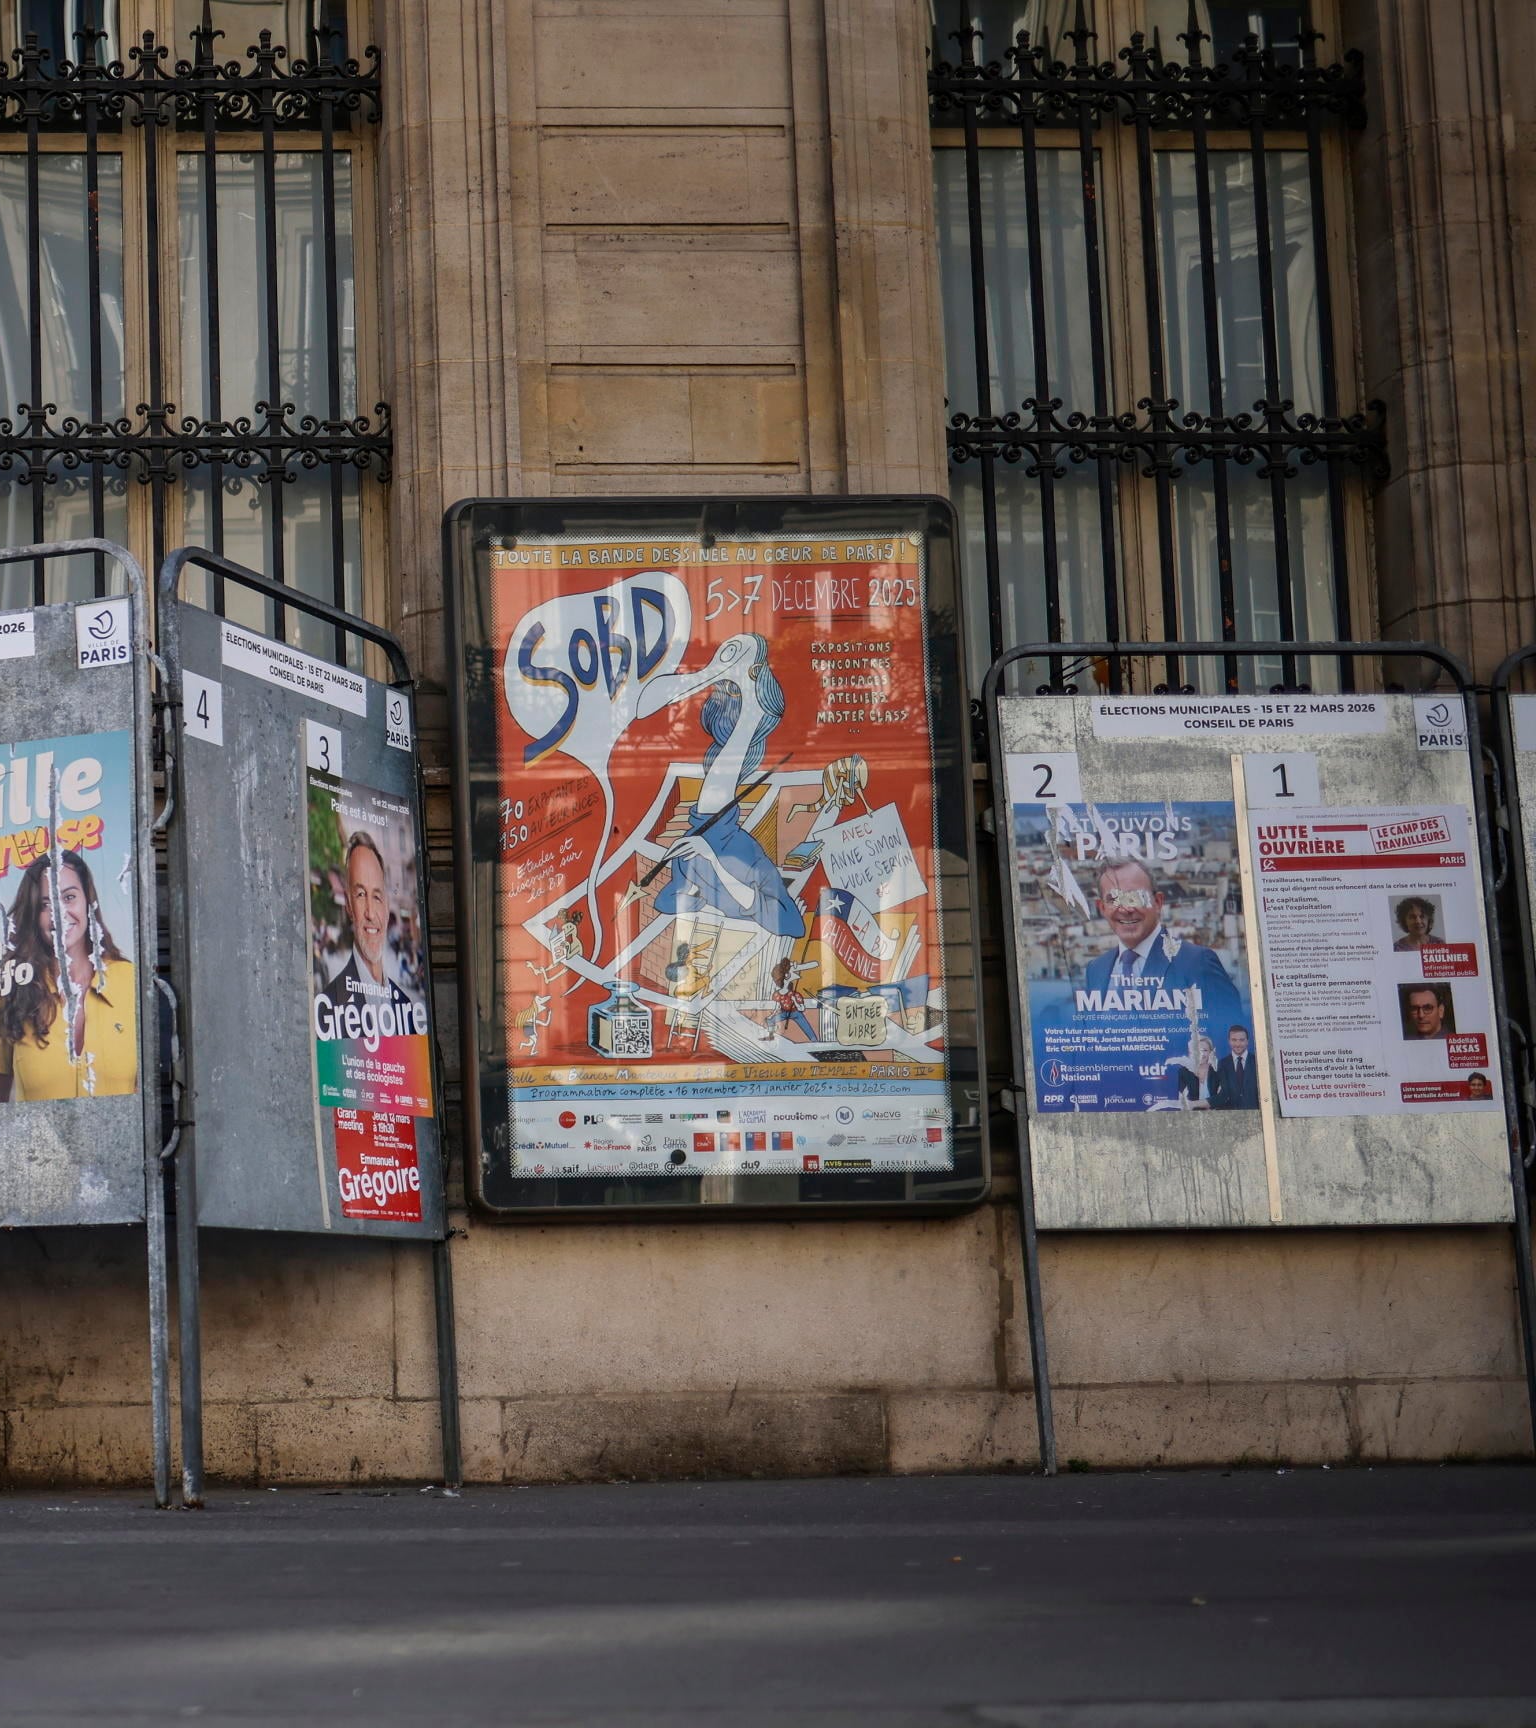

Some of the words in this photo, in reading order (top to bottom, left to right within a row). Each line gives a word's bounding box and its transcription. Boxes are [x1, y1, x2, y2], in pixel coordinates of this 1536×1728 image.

[495, 550, 552, 565] TOUTE
[560, 549, 582, 564] LA
[588, 548, 645, 565] BANDE
[735, 547, 757, 562] AU
[821, 545, 838, 561] DE
[771, 572, 862, 613] DÉCEMBRE
[868, 578, 917, 608] 2025
[80, 645, 127, 665] PARIS
[811, 642, 891, 654] EXPOSITIONS
[226, 632, 261, 653] ÉLECTIONS
[262, 647, 304, 671] MUNICIPALES
[308, 664, 314, 674] 15
[315, 668, 322, 677] ET
[323, 671, 331, 681] 22
[331, 674, 348, 688] MARS
[349, 680, 363, 694] 2026
[811, 658, 891, 670] RENCONTRES
[269, 665, 295, 683] CONSEIL
[296, 675, 305, 686] DE
[306, 679, 324, 693] PARIS
[827, 692, 888, 705] ATELIERS
[196, 689, 210, 729] 4
[816, 709, 865, 724] MASTER
[869, 710, 909, 723] CLASS
[1100, 705, 1165, 715] ÉLECTIONS
[1169, 705, 1250, 714] MUNICIPALES
[1260, 704, 1272, 713] 15
[1276, 704, 1290, 713] ET
[1293, 704, 1307, 713] 22
[1309, 704, 1344, 712] MARS
[1347, 703, 1375, 712] 2026
[1184, 719, 1236, 728] CONSEIL
[1238, 719, 1255, 727] DE
[1258, 718, 1294, 727] PARIS
[386, 729, 409, 748] PARIS
[1418, 734, 1463, 746] PARIS
[319, 735, 330, 773] 3
[1032, 763, 1057, 798] 2
[1272, 763, 1296, 798] 1
[330, 798, 348, 815] Paris
[349, 806, 361, 819] est
[362, 808, 367, 821] à
[841, 822, 873, 843] AVEC
[1257, 825, 1308, 840] LUTTE
[1376, 828, 1389, 838] LE
[1390, 823, 1420, 837] CAMP
[1421, 819, 1439, 831] DES
[1258, 837, 1345, 856] OUVRIÈRE
[1375, 830, 1446, 851] TRAVAILLEURS
[830, 850, 863, 874] ANNE
[1439, 855, 1465, 865] PARIS
[1422, 954, 1469, 963] SAULNIER
[345, 975, 393, 999] Emmanuel
[1111, 974, 1165, 989] Thierry
[845, 1003, 882, 1019] ENTRÉE
[314, 990, 428, 1053] Grégoire
[1448, 1044, 1480, 1054] AKSAS
[341, 1054, 365, 1068] L'union
[365, 1058, 374, 1069] de
[375, 1060, 382, 1070] la
[382, 1061, 405, 1074] gauche
[869, 1065, 911, 1078] PARIS
[1060, 1064, 1133, 1073] Rassemblement
[1061, 1073, 1101, 1082] National
[359, 1153, 395, 1167] Emmanuel
[338, 1160, 420, 1207] Grégoire
